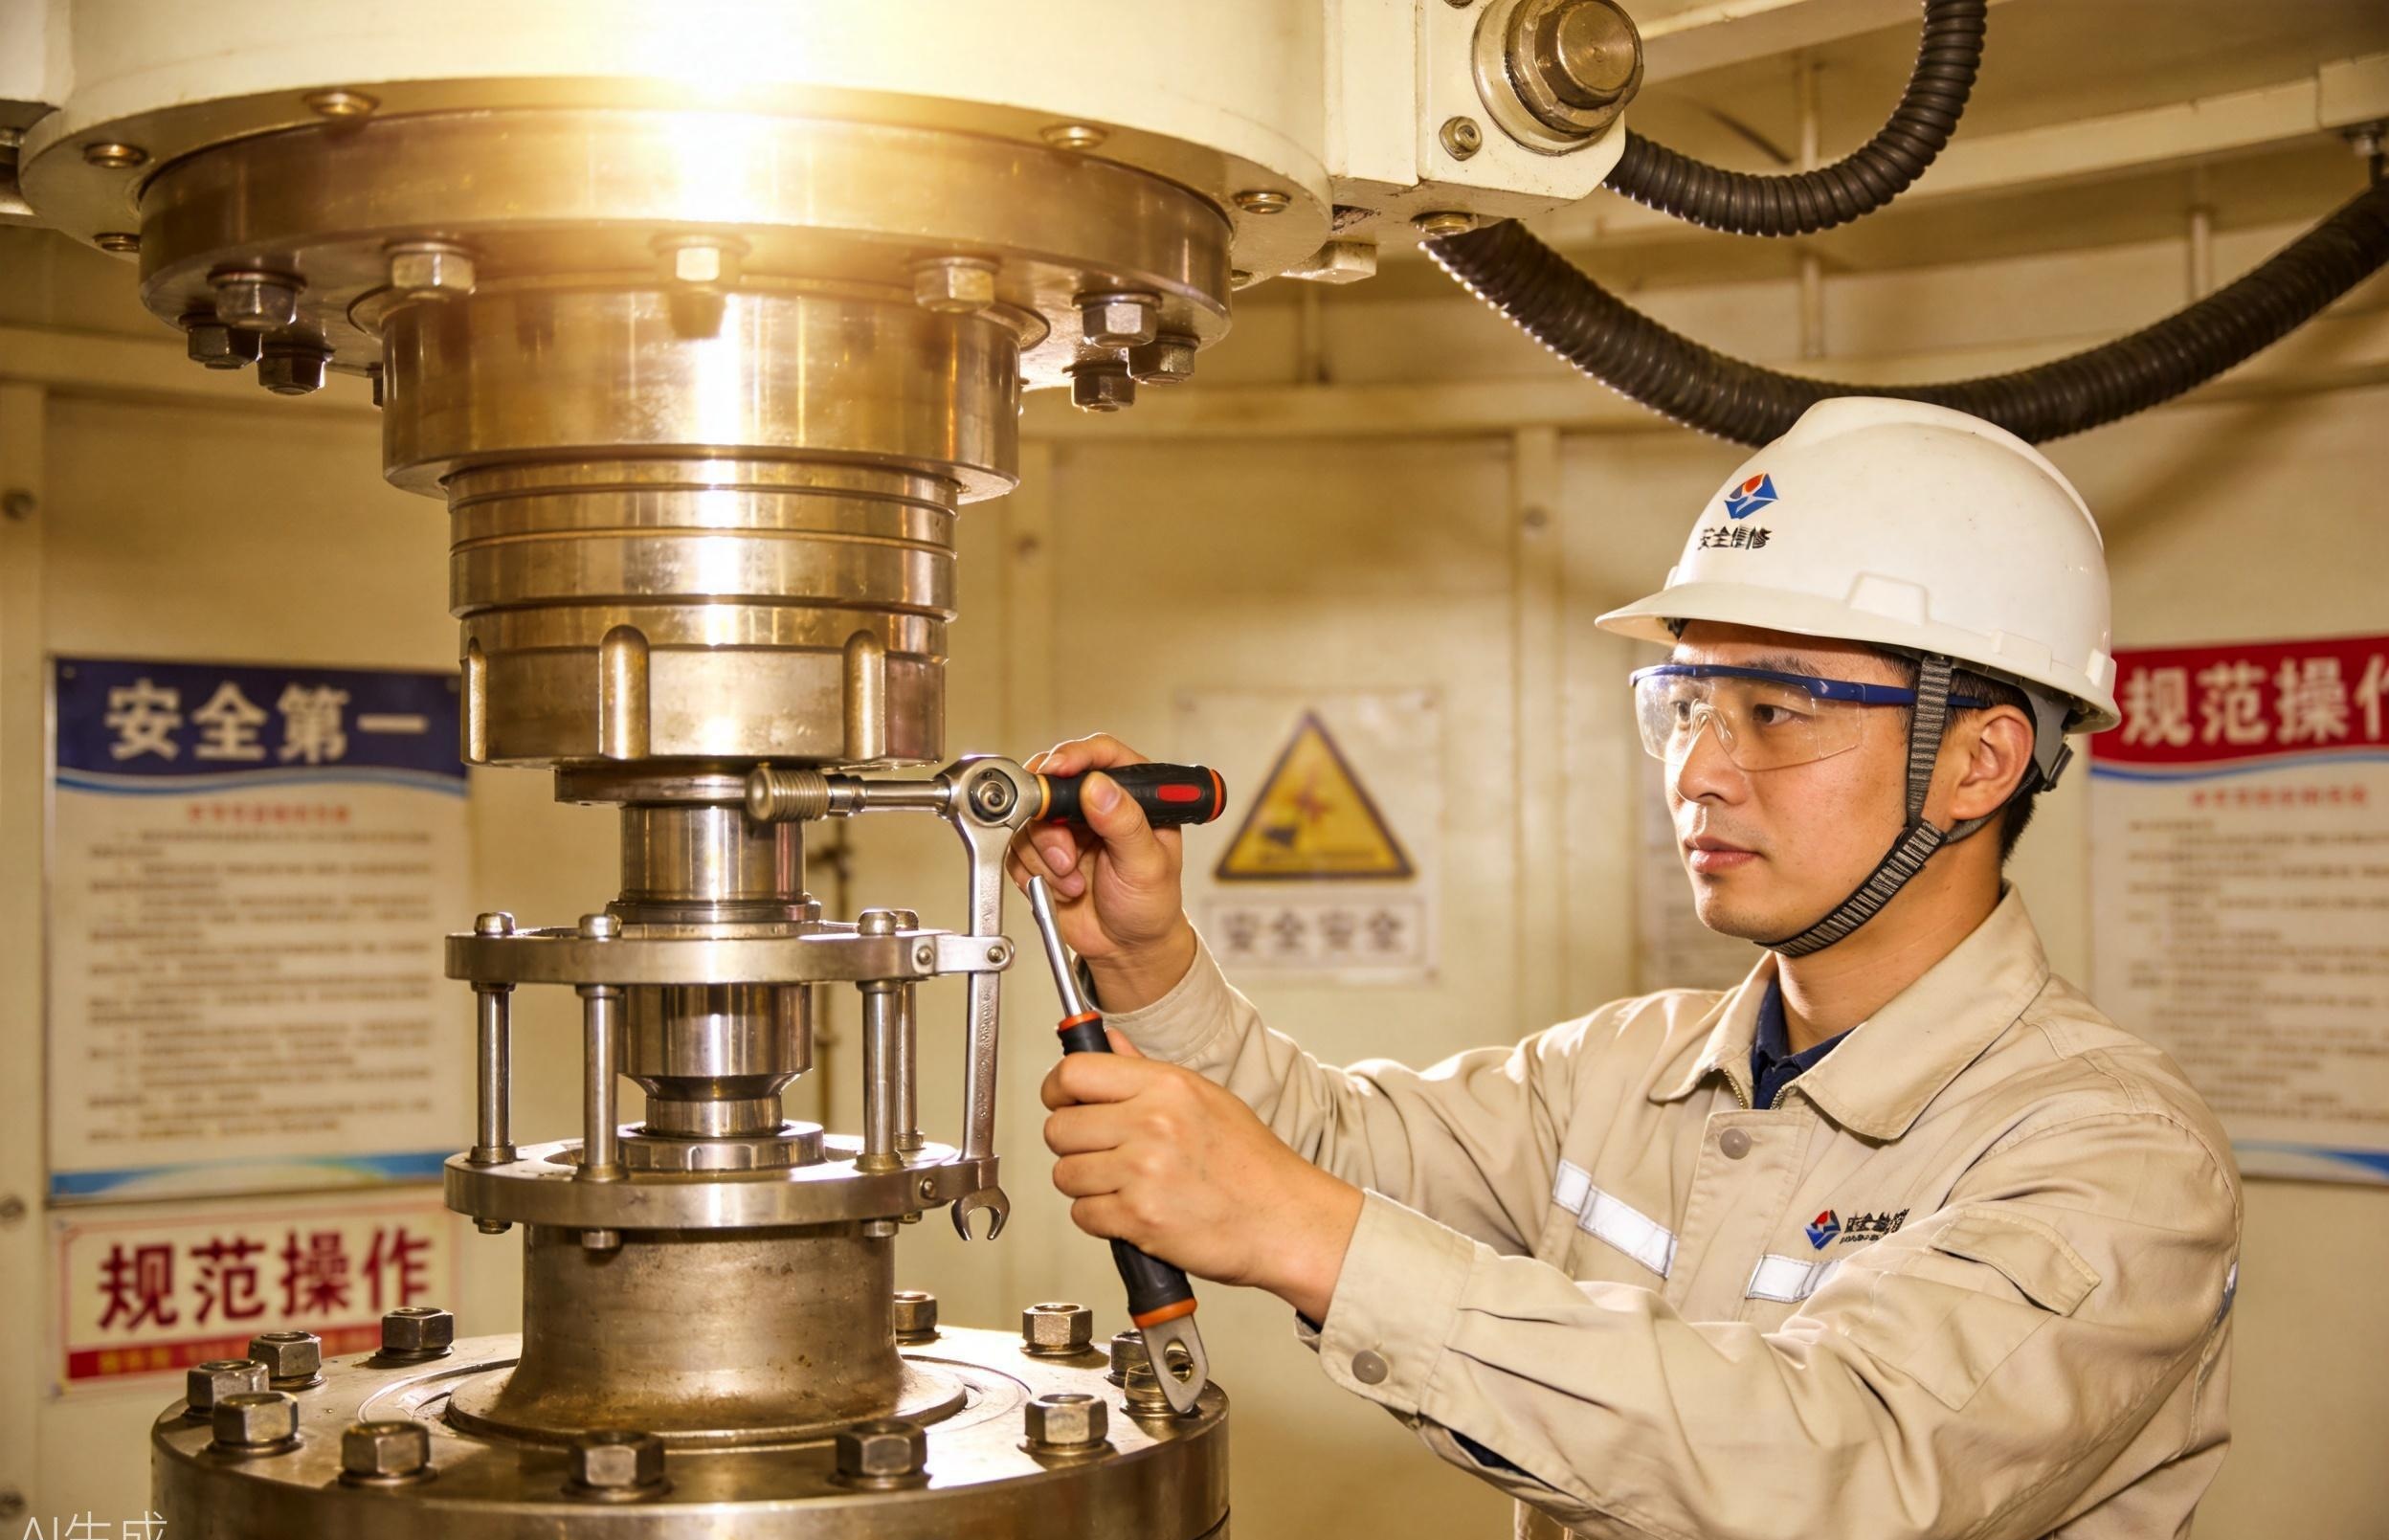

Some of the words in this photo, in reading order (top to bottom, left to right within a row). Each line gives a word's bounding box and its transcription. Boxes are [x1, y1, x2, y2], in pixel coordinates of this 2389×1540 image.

[104, 678, 429, 763] 安全第一
[98, 1226, 433, 1331] 规范操作
